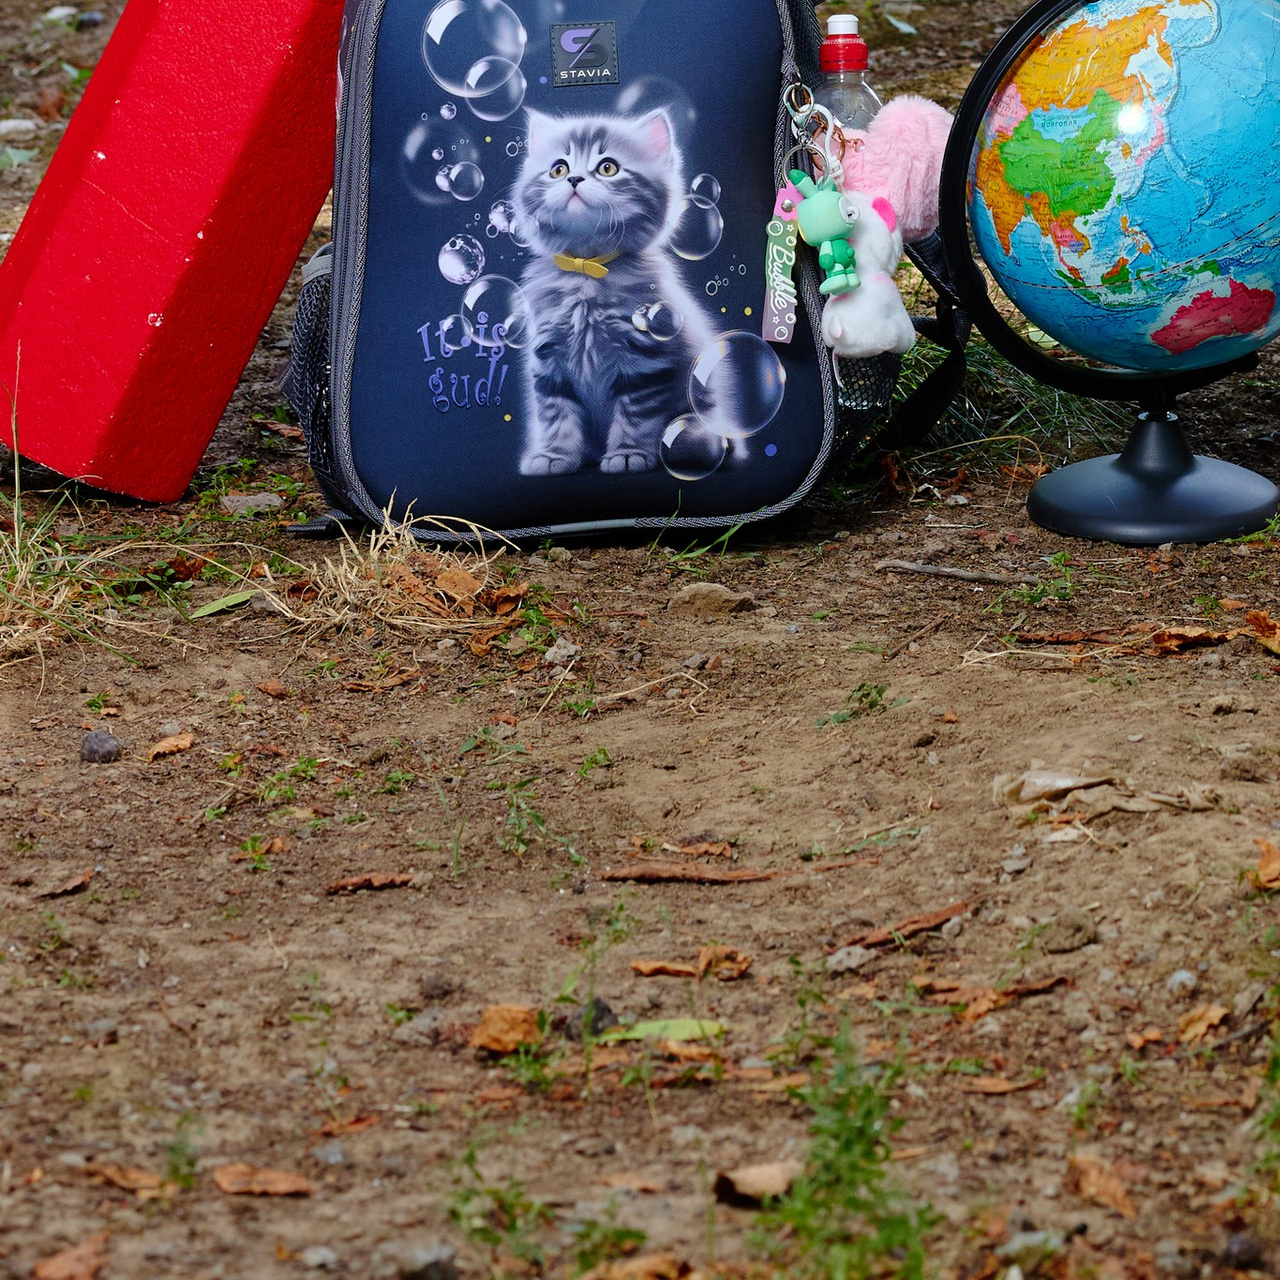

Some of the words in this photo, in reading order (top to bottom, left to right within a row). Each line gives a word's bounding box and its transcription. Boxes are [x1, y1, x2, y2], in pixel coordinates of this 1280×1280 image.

[560, 68, 611, 79] STAVIA
[772, 244, 798, 310] Bubble
[417, 319, 454, 363] It
[475, 311, 509, 359] is
[428, 358, 509, 413] gud!
